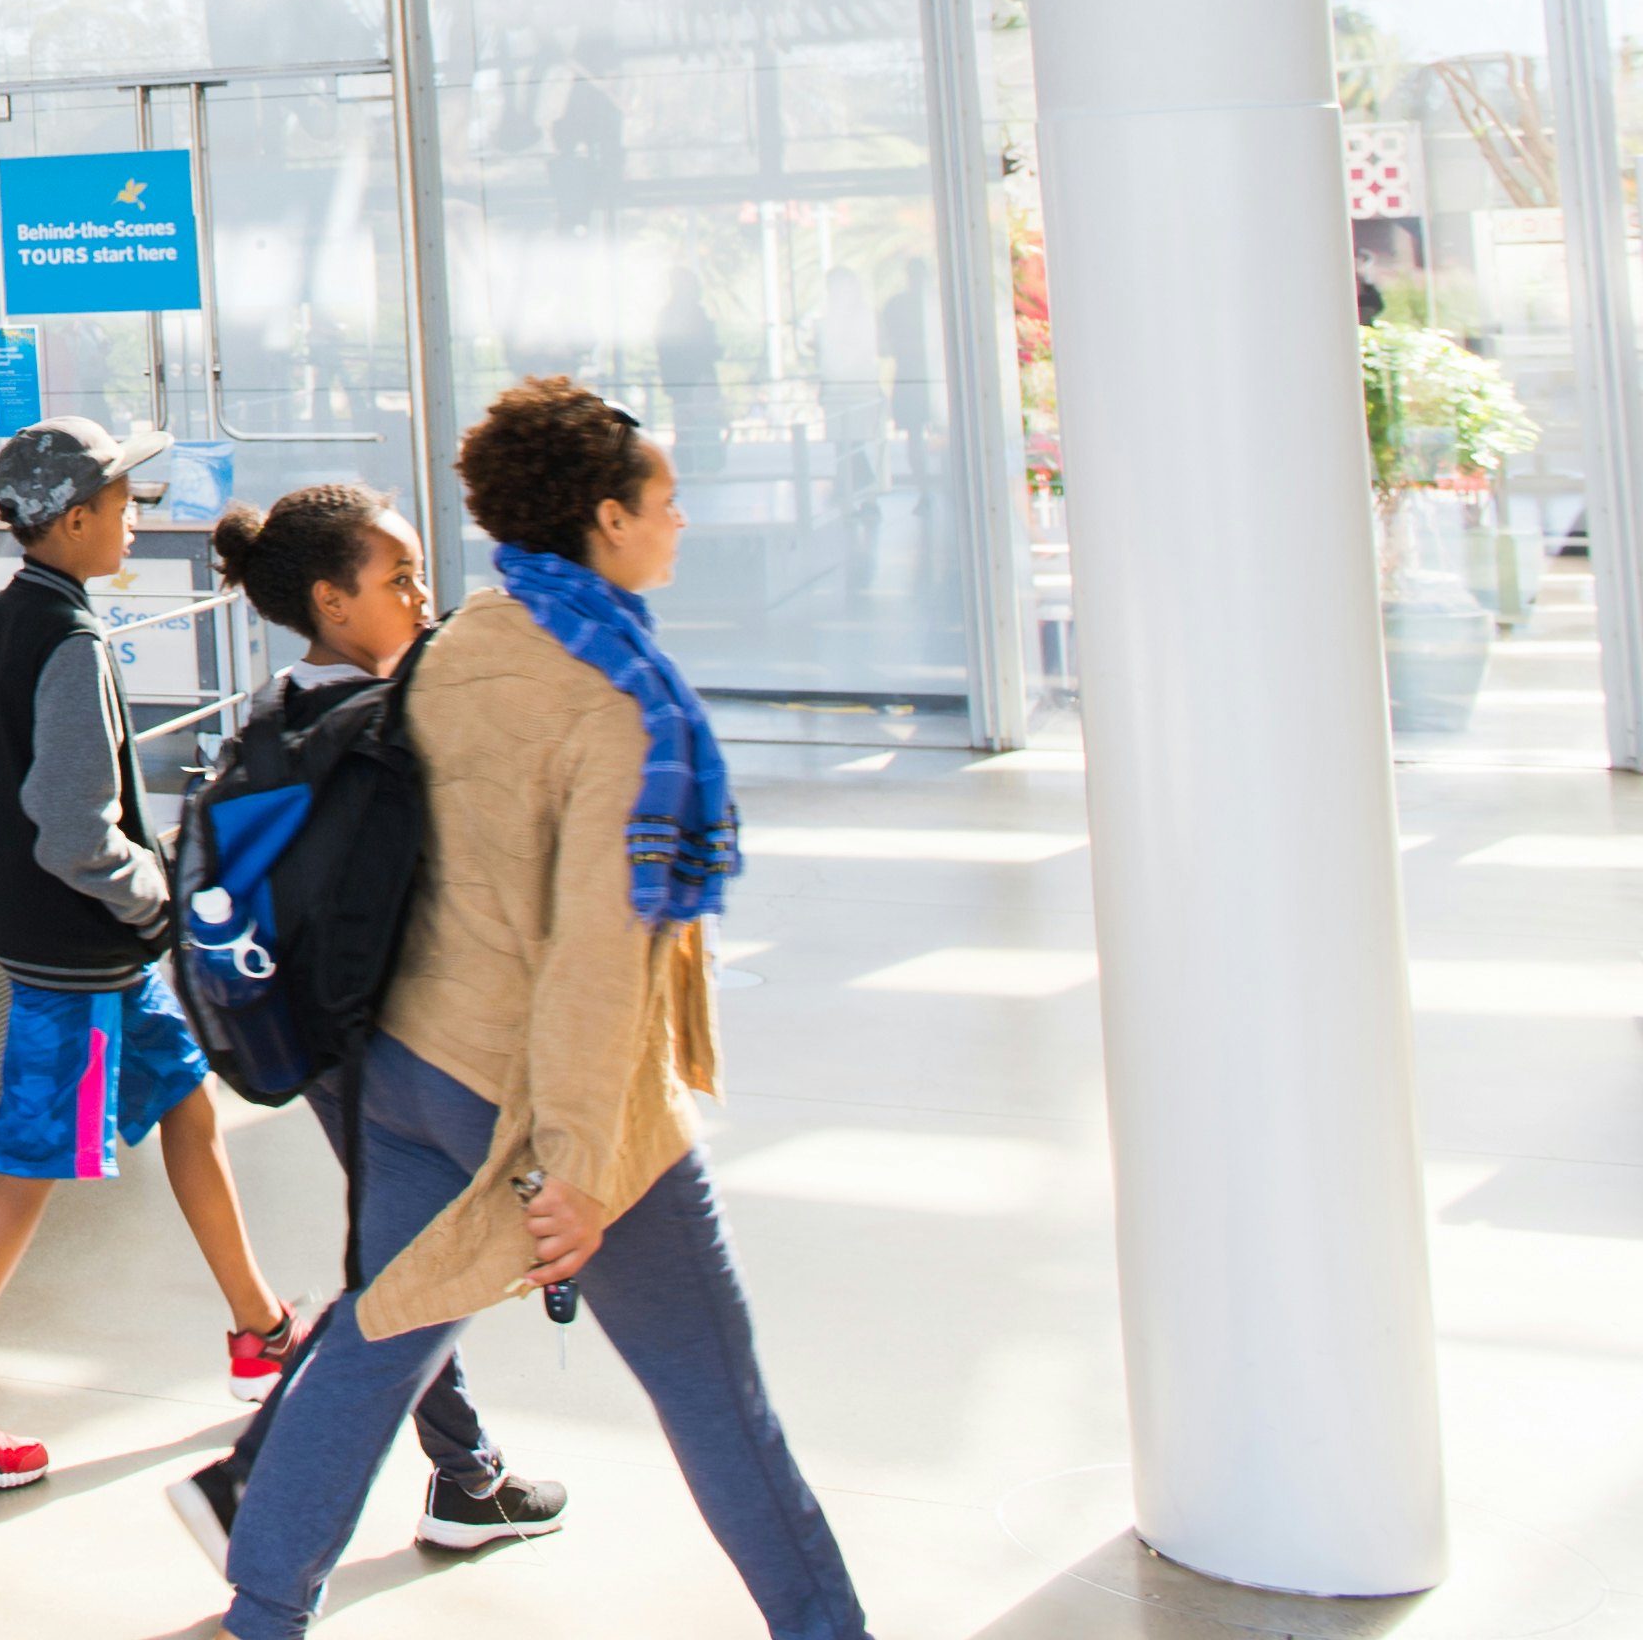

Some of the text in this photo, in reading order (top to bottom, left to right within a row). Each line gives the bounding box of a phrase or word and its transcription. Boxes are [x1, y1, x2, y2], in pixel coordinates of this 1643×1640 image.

[17, 220, 176, 241] Behind-the-Scenes
[18, 244, 178, 265] TOURS start here
